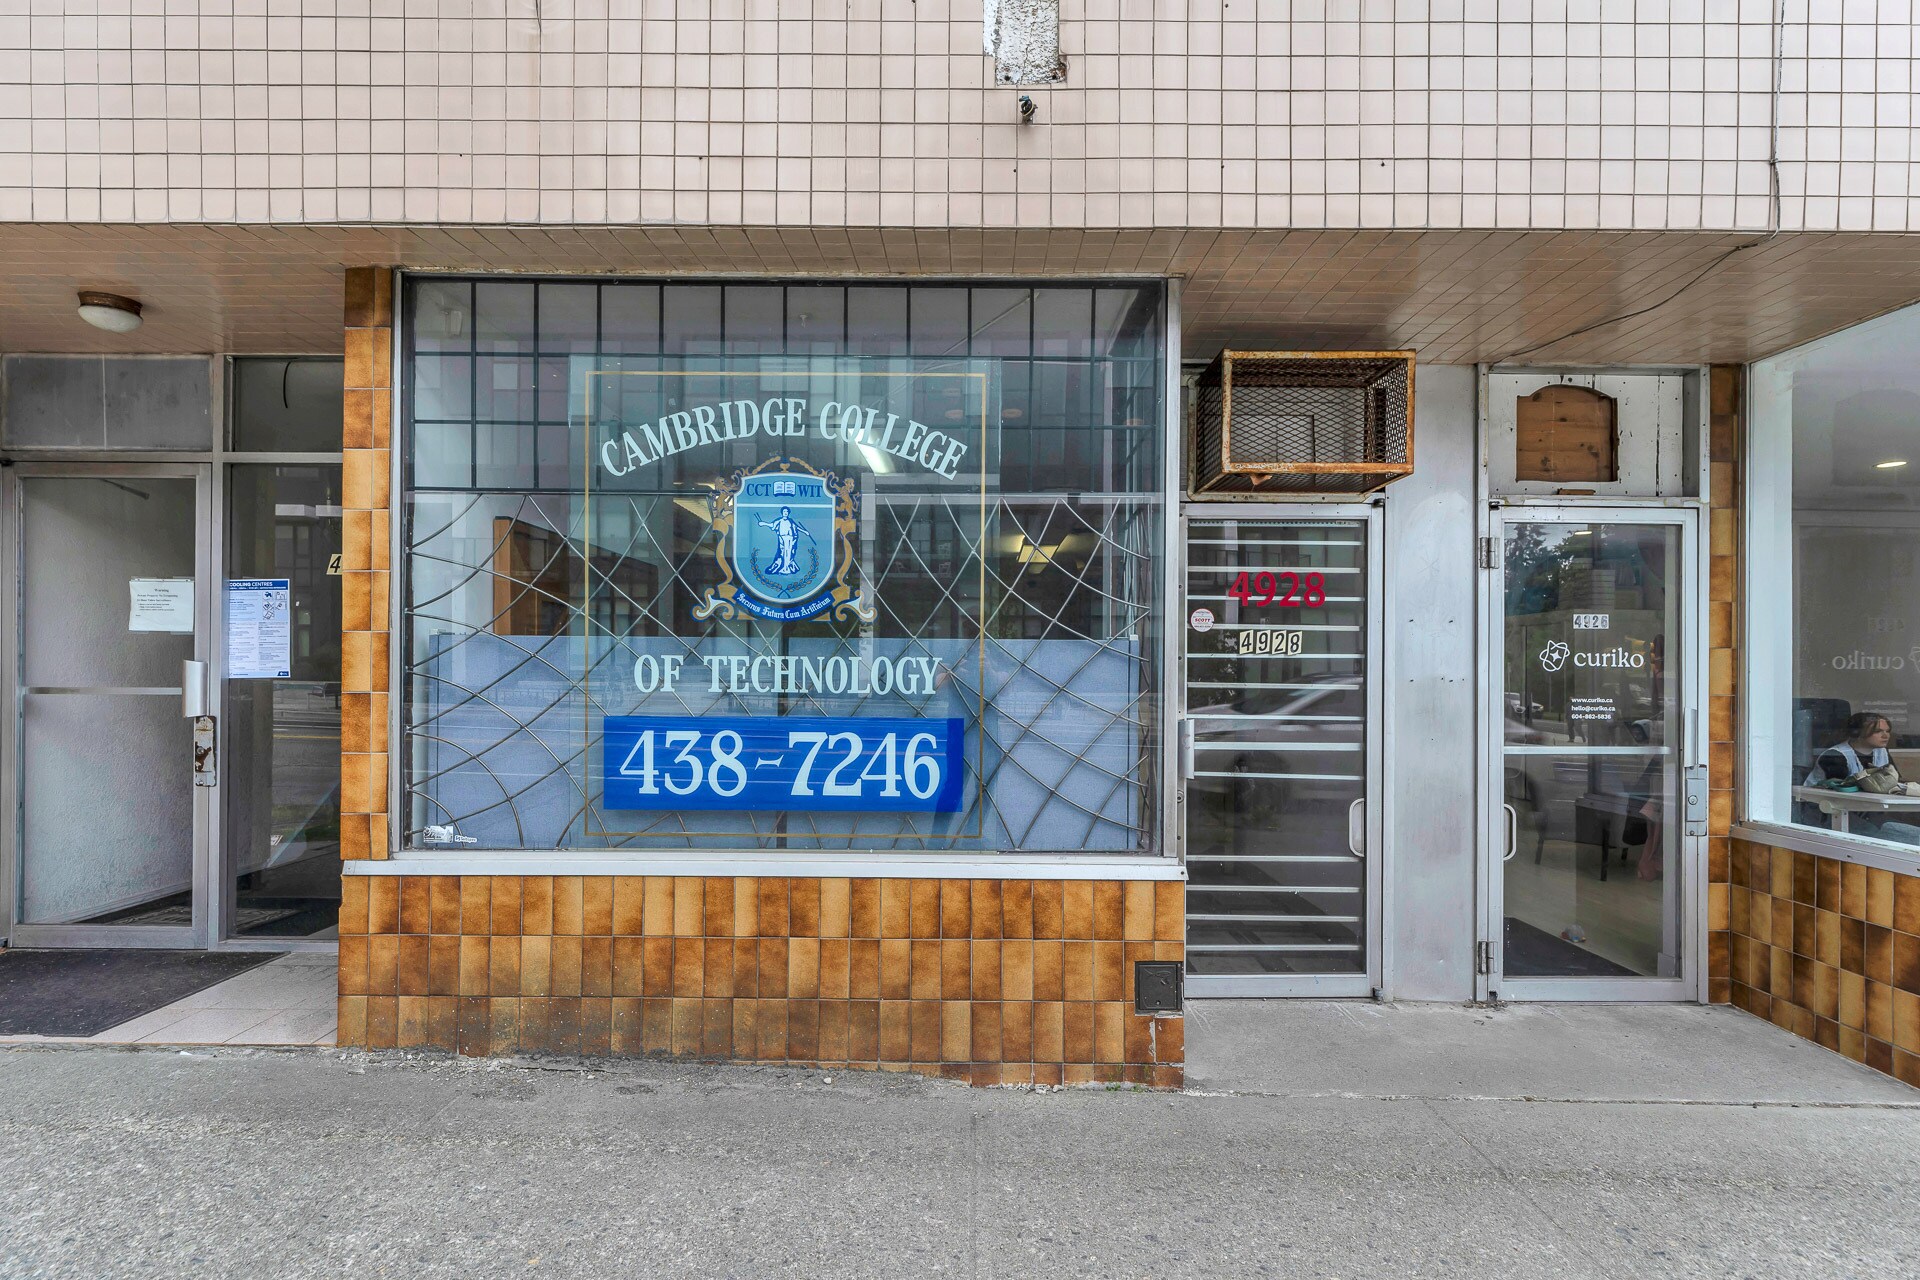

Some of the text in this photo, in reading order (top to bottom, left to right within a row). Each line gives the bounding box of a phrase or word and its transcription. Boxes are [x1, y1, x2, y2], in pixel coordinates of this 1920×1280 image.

[601, 398, 968, 481] CAMBRIDGE COLLEGE
[746, 483, 823, 498] CCT WIT
[329, 555, 342, 574] 4
[1228, 571, 1326, 609] 4928
[784, 609, 801, 619] Cum
[1574, 615, 1608, 629] 4926
[1241, 633, 1300, 654] 4928
[1573, 647, 1645, 668] curiko
[633, 654, 943, 695] OF TECHNOLOGY
[619, 729, 941, 800] 438-7246
